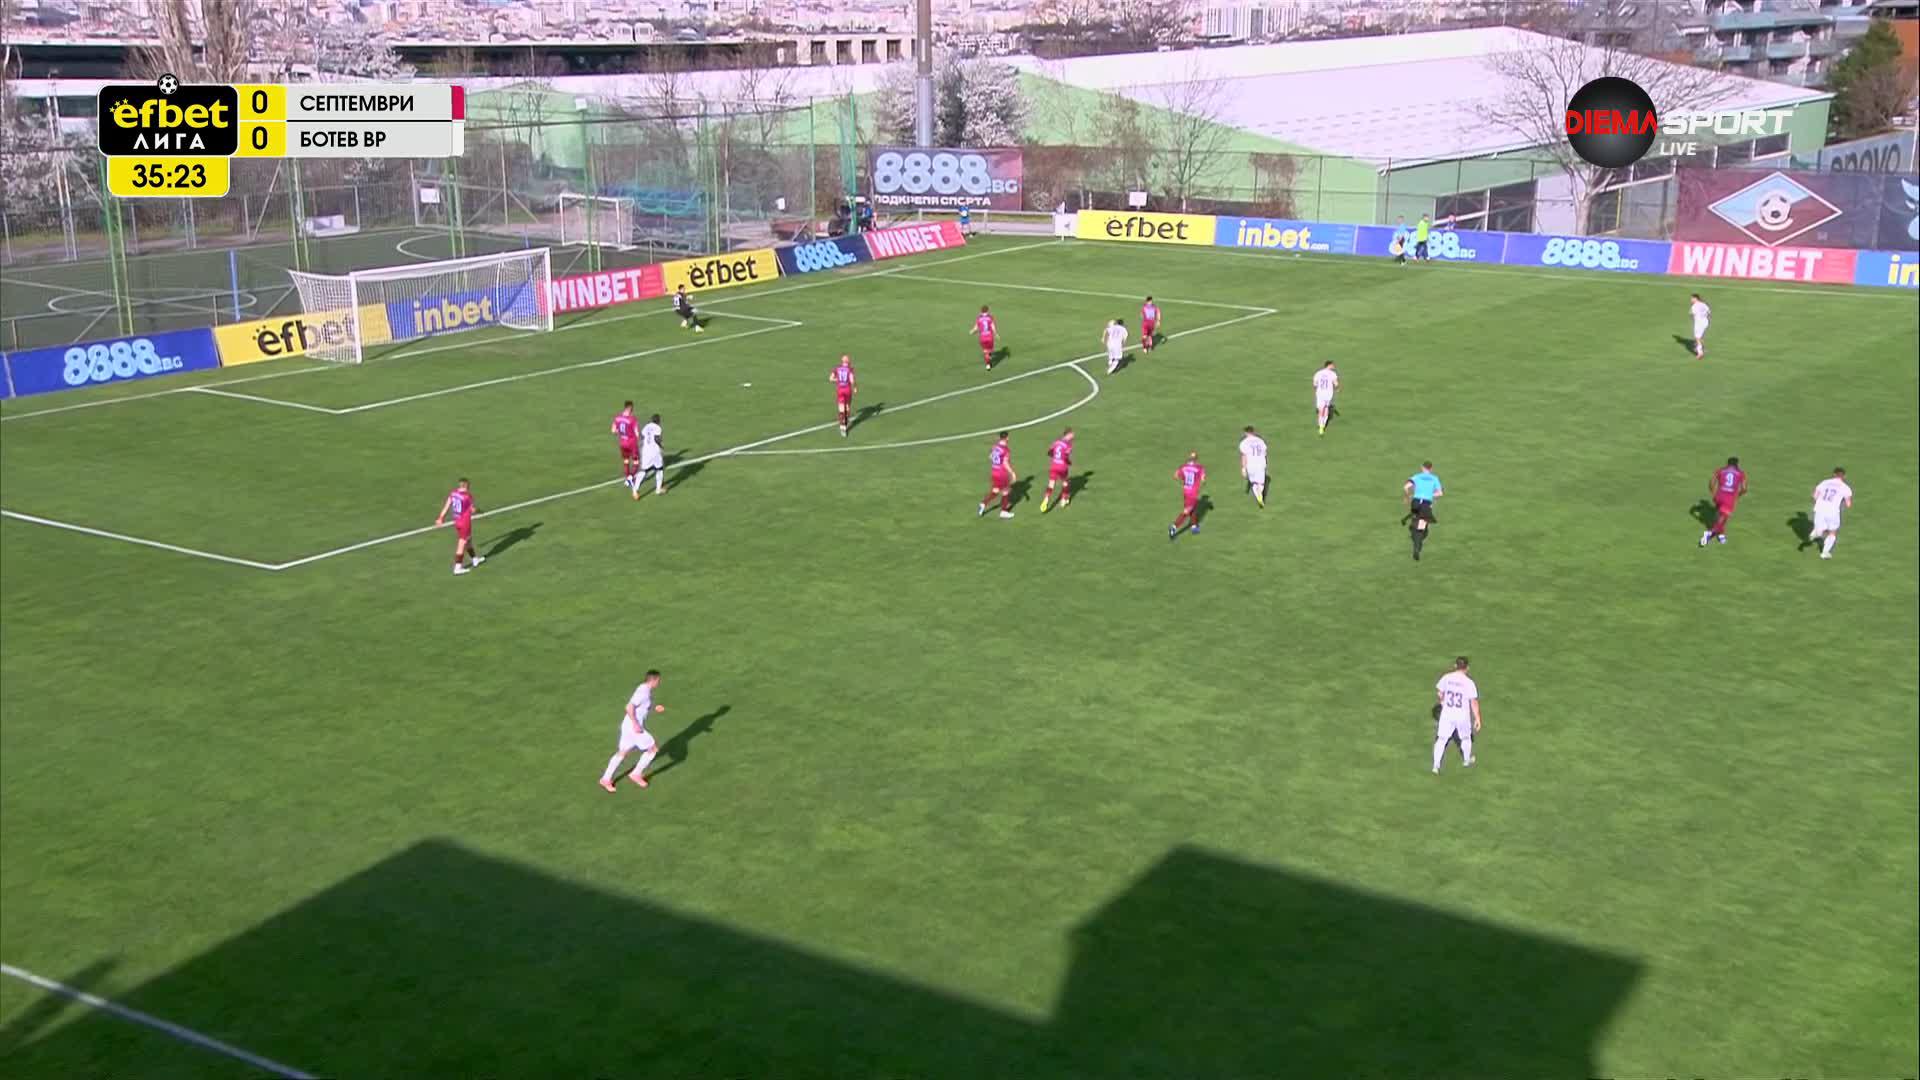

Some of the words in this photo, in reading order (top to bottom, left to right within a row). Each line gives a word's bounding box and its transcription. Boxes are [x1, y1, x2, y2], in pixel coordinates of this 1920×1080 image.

[871, 224, 946, 258] WINBET
[1104, 216, 1189, 240] efbet
[688, 256, 759, 288] efbet
[1682, 246, 1823, 280] WINBET
[546, 269, 642, 312] WINBET
[413, 295, 495, 334] inbet
[254, 313, 359, 356] efbet
[1446, 690, 1463, 708] 33
